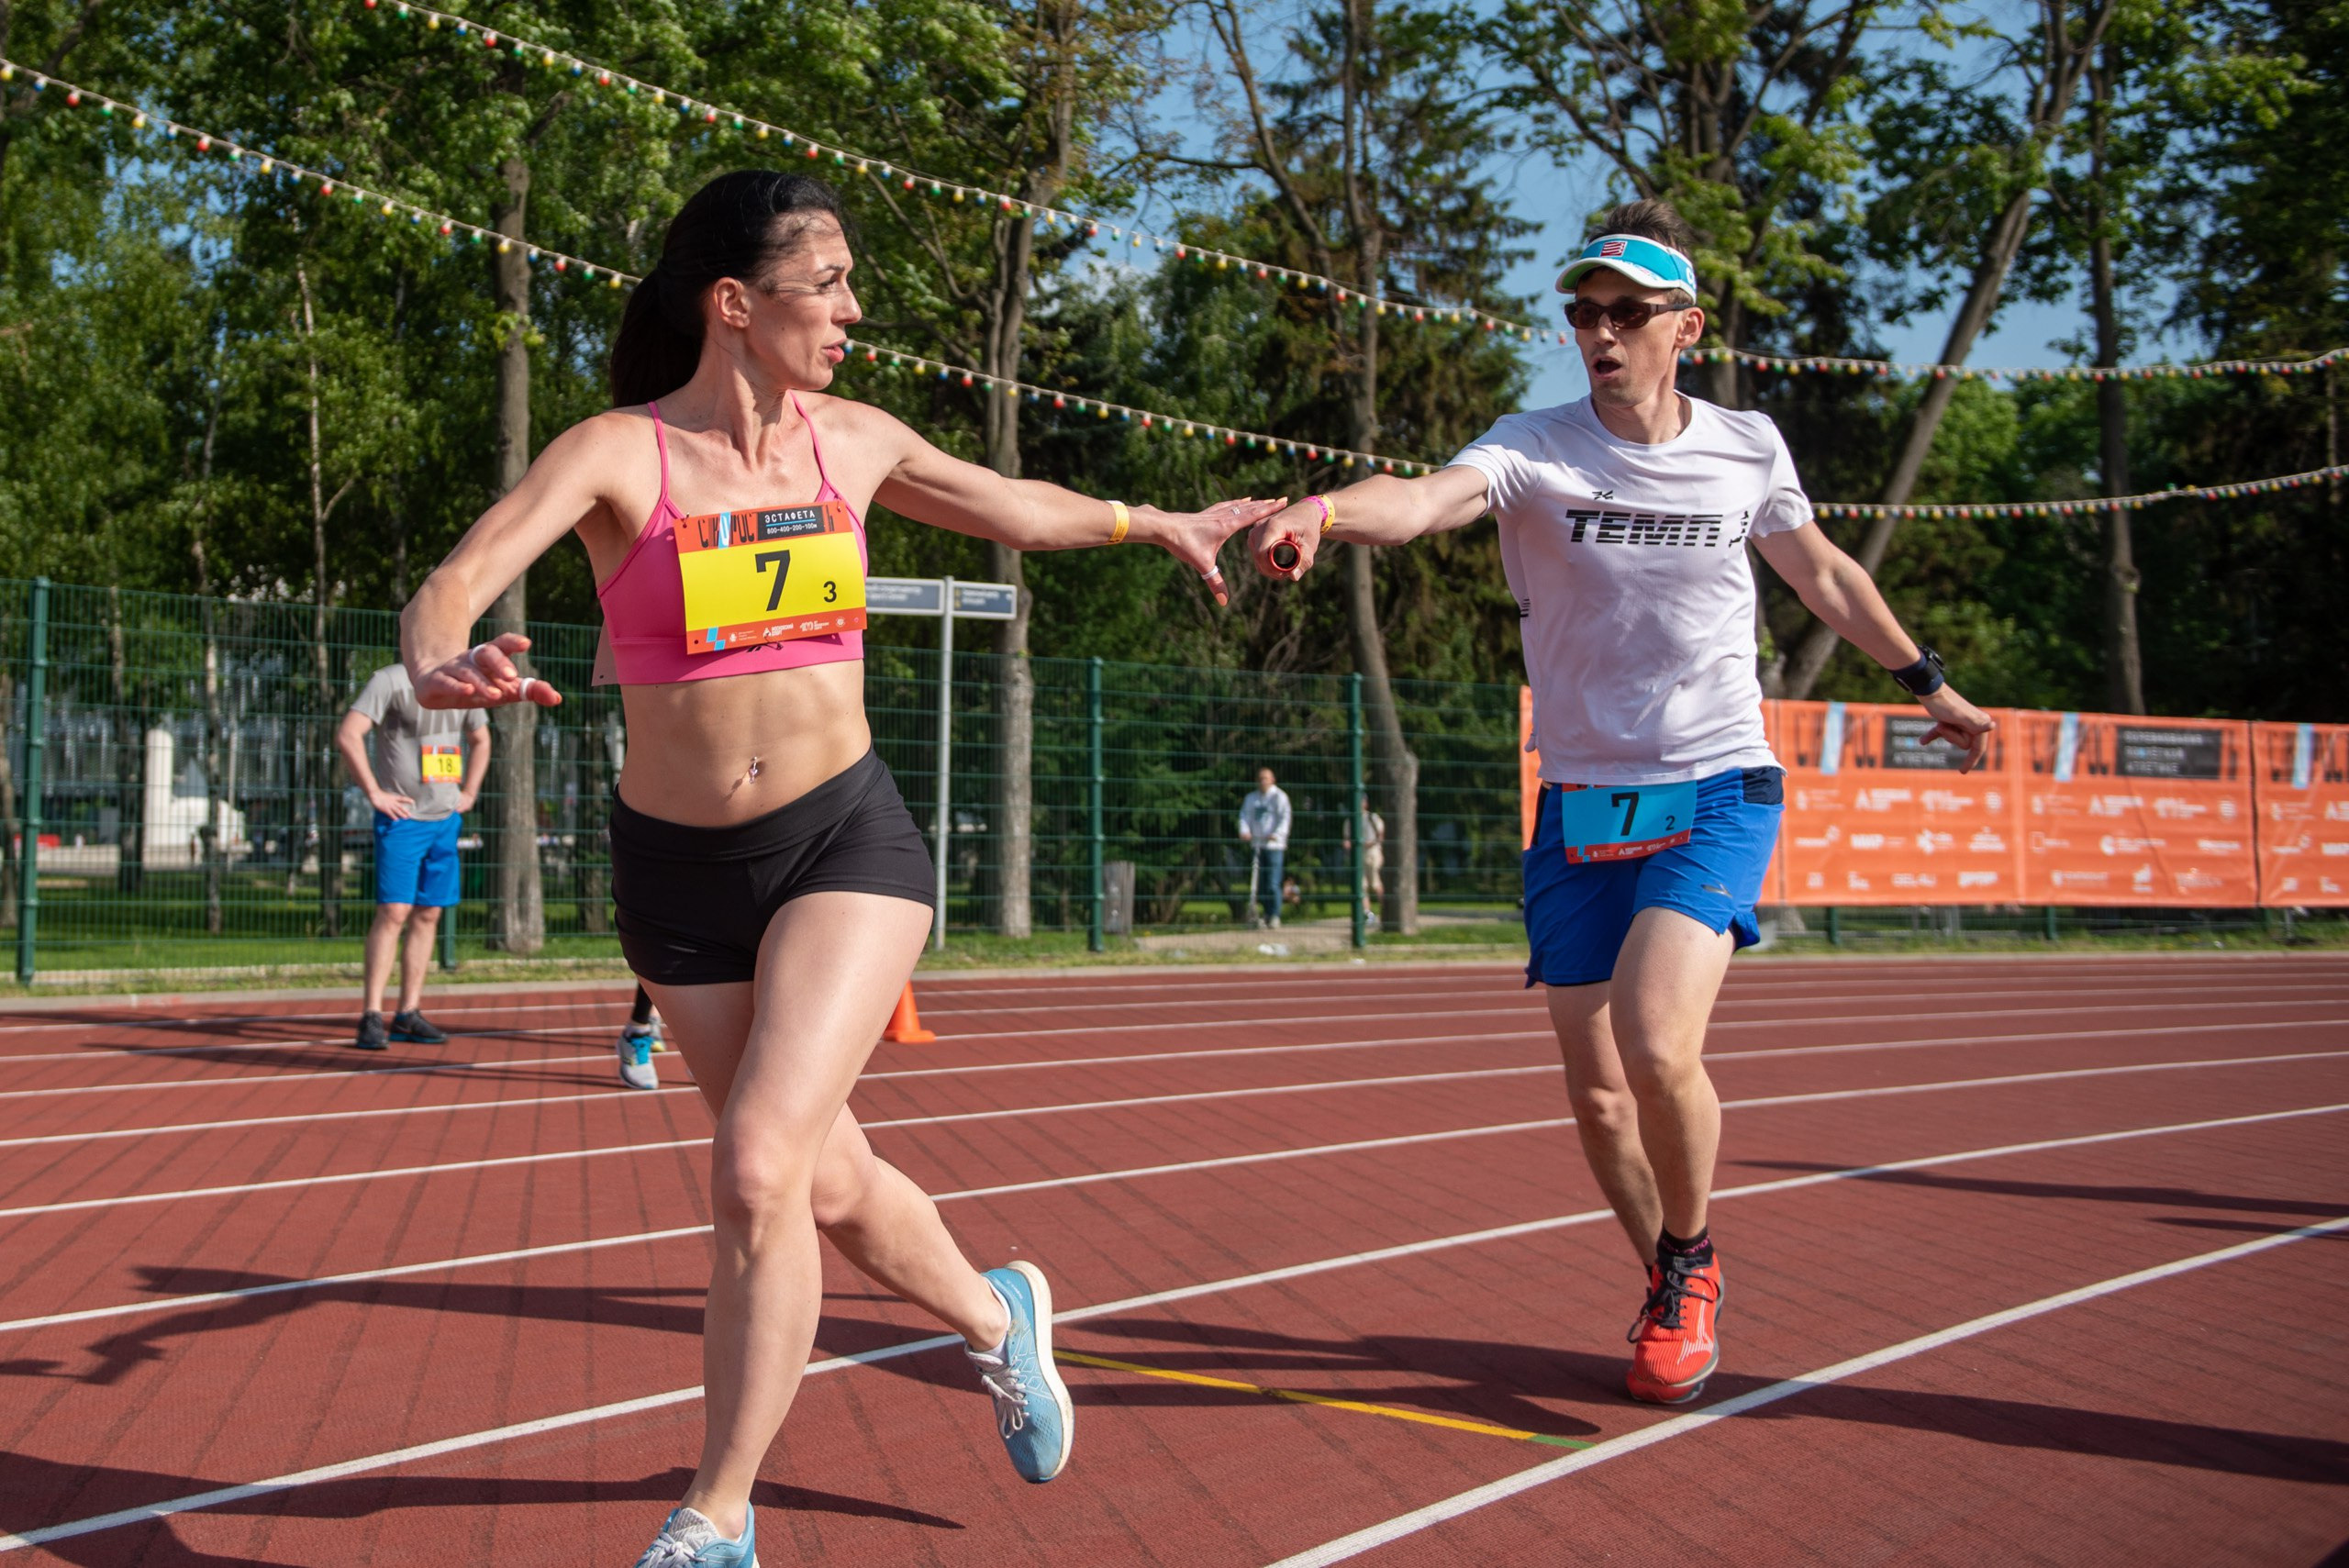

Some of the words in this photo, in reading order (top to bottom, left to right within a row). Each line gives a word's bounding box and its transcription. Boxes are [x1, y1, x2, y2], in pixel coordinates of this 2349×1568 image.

[764, 509, 816, 524] ЭСТАФЕТА
[1565, 508, 1723, 547] ТЕМП
[754, 549, 791, 612] 7
[823, 580, 837, 603] 3
[438, 758, 452, 773] 18
[1611, 791, 1639, 836] 7
[1665, 815, 1675, 831] 2
